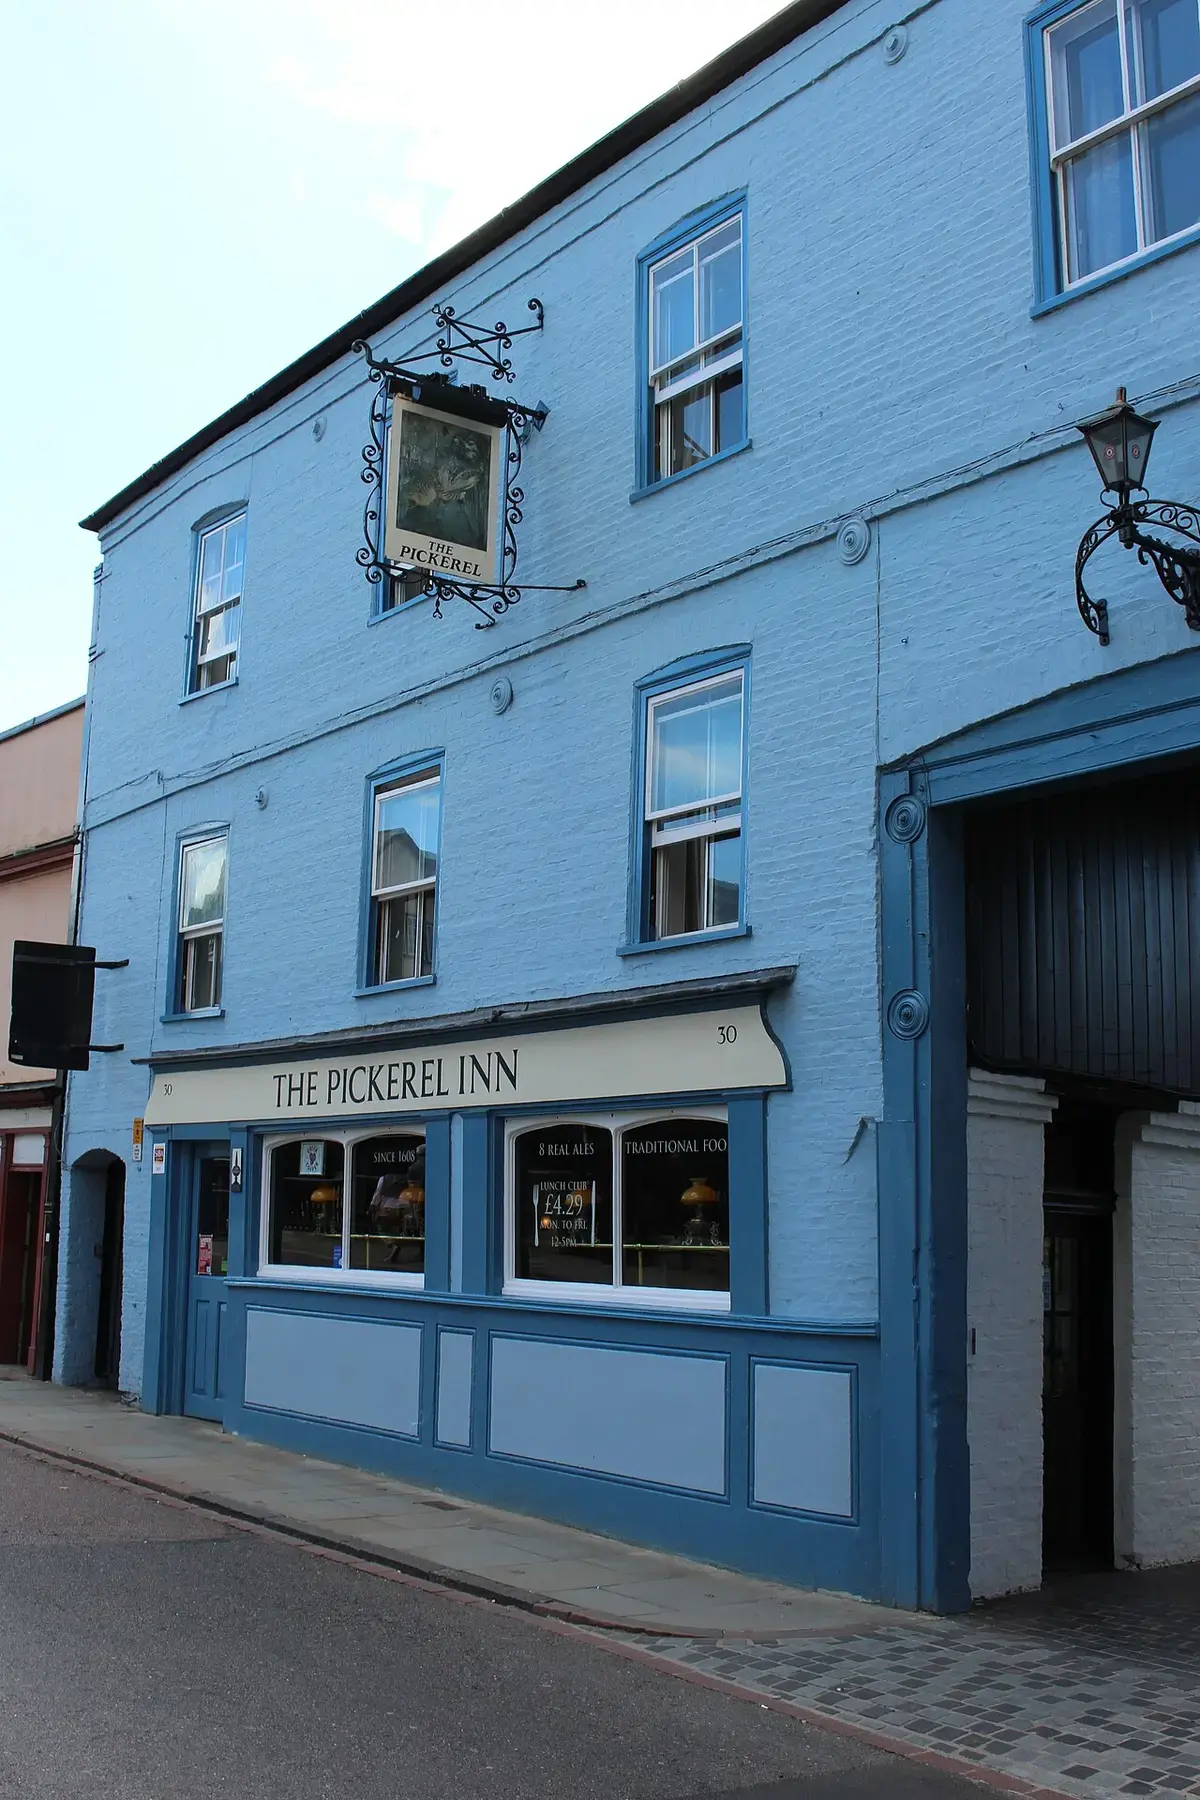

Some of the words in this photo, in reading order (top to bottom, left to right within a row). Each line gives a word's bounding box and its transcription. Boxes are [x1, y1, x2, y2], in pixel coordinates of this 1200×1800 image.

[429, 541, 453, 555] THE
[399, 545, 481, 576] PICKEREL
[717, 1025, 737, 1045] 30
[273, 1071, 319, 1108] THE
[326, 1059, 449, 1105] PICKEREL
[459, 1049, 519, 1095] INN
[163, 1083, 173, 1096] 30
[539, 1143, 545, 1156] 8
[548, 1144, 570, 1156] REAL
[572, 1143, 595, 1155] ALES
[625, 1141, 699, 1154] TRADITIONAL
[703, 1138, 727, 1151] FOO
[373, 1151, 396, 1163] SINCE
[398, 1150, 416, 1162] 1608
[540, 1181, 566, 1191] LUNCH
[568, 1181, 587, 1191] CLUB
[545, 1193, 583, 1216] £4.29
[562, 1220, 573, 1229] TO
[574, 1220, 588, 1230] FRI.
[551, 1236, 577, 1248] 12-5PM
